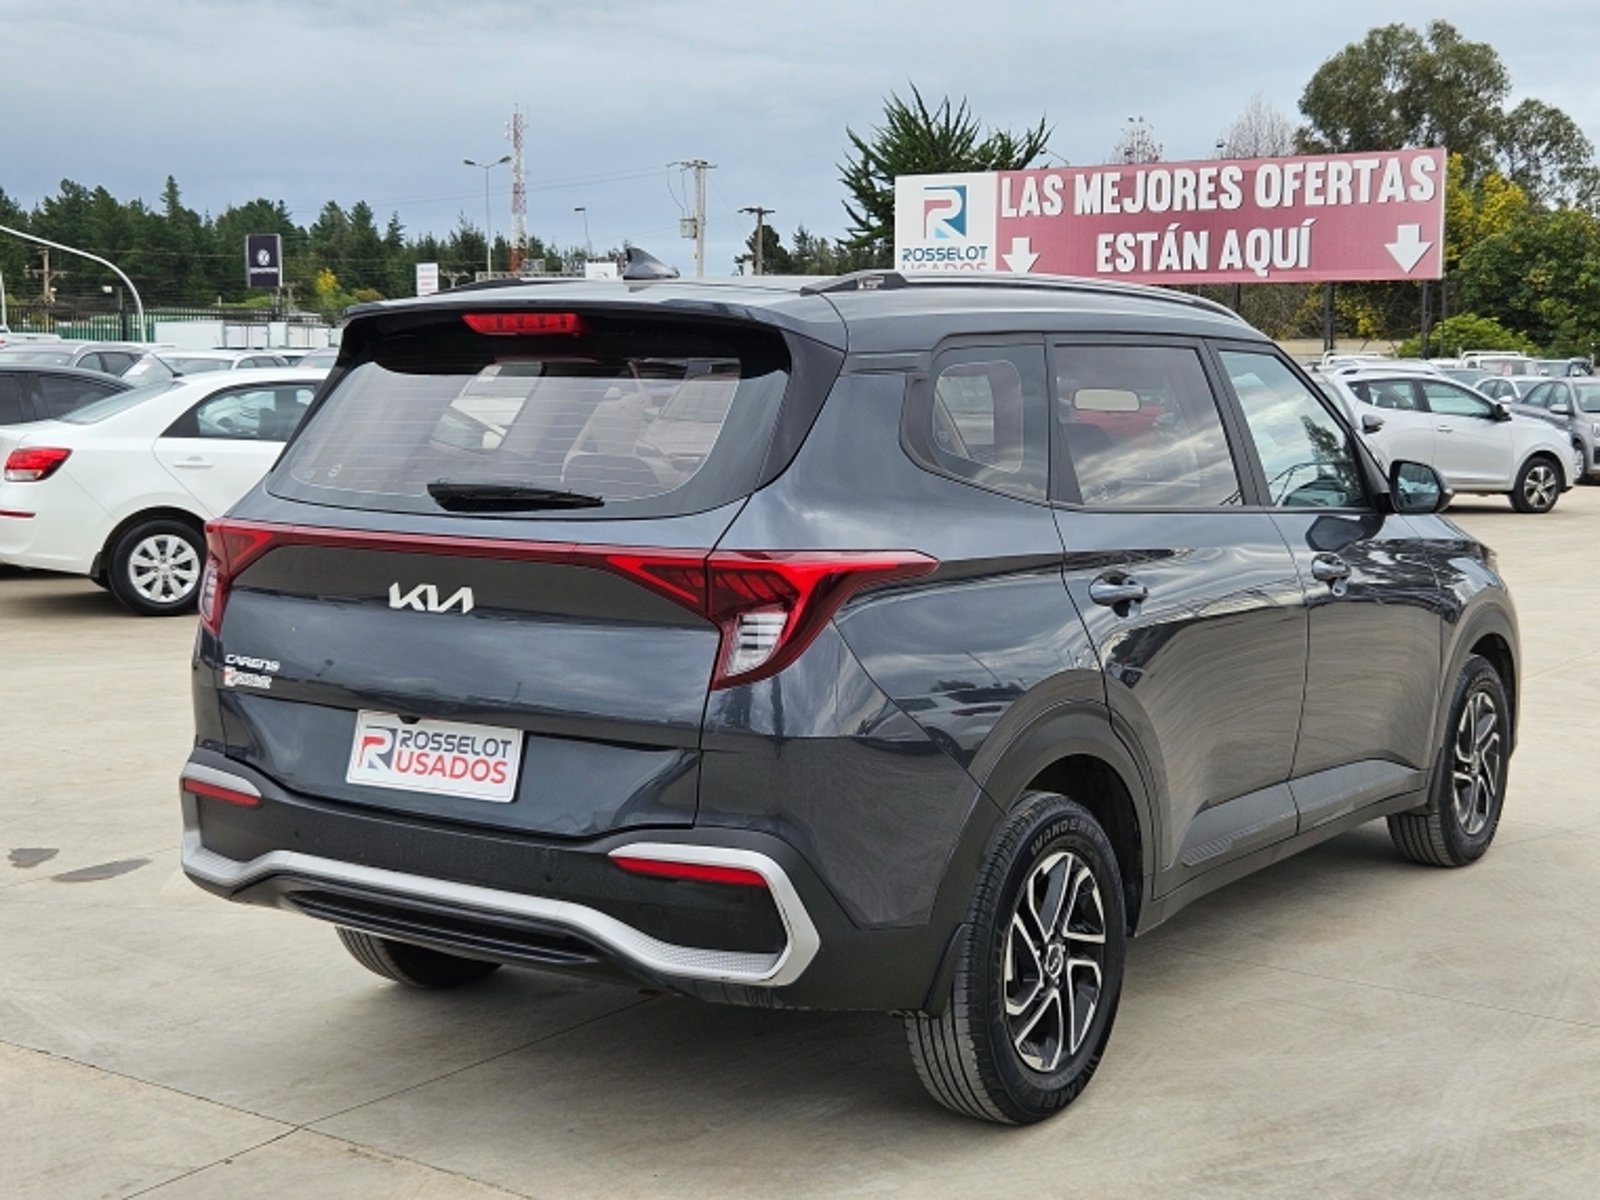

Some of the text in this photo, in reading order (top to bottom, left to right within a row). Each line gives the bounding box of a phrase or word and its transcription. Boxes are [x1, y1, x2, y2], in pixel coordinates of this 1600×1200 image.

[1001, 157, 1438, 218] LAS MEJORES OFERTAS
[902, 246, 988, 262] ROSSELOT
[1097, 218, 1316, 277] ESTÁN AQUÍ
[388, 581, 475, 614] KIA
[399, 730, 512, 758] ROSSELOT
[395, 751, 508, 784] USADOS
